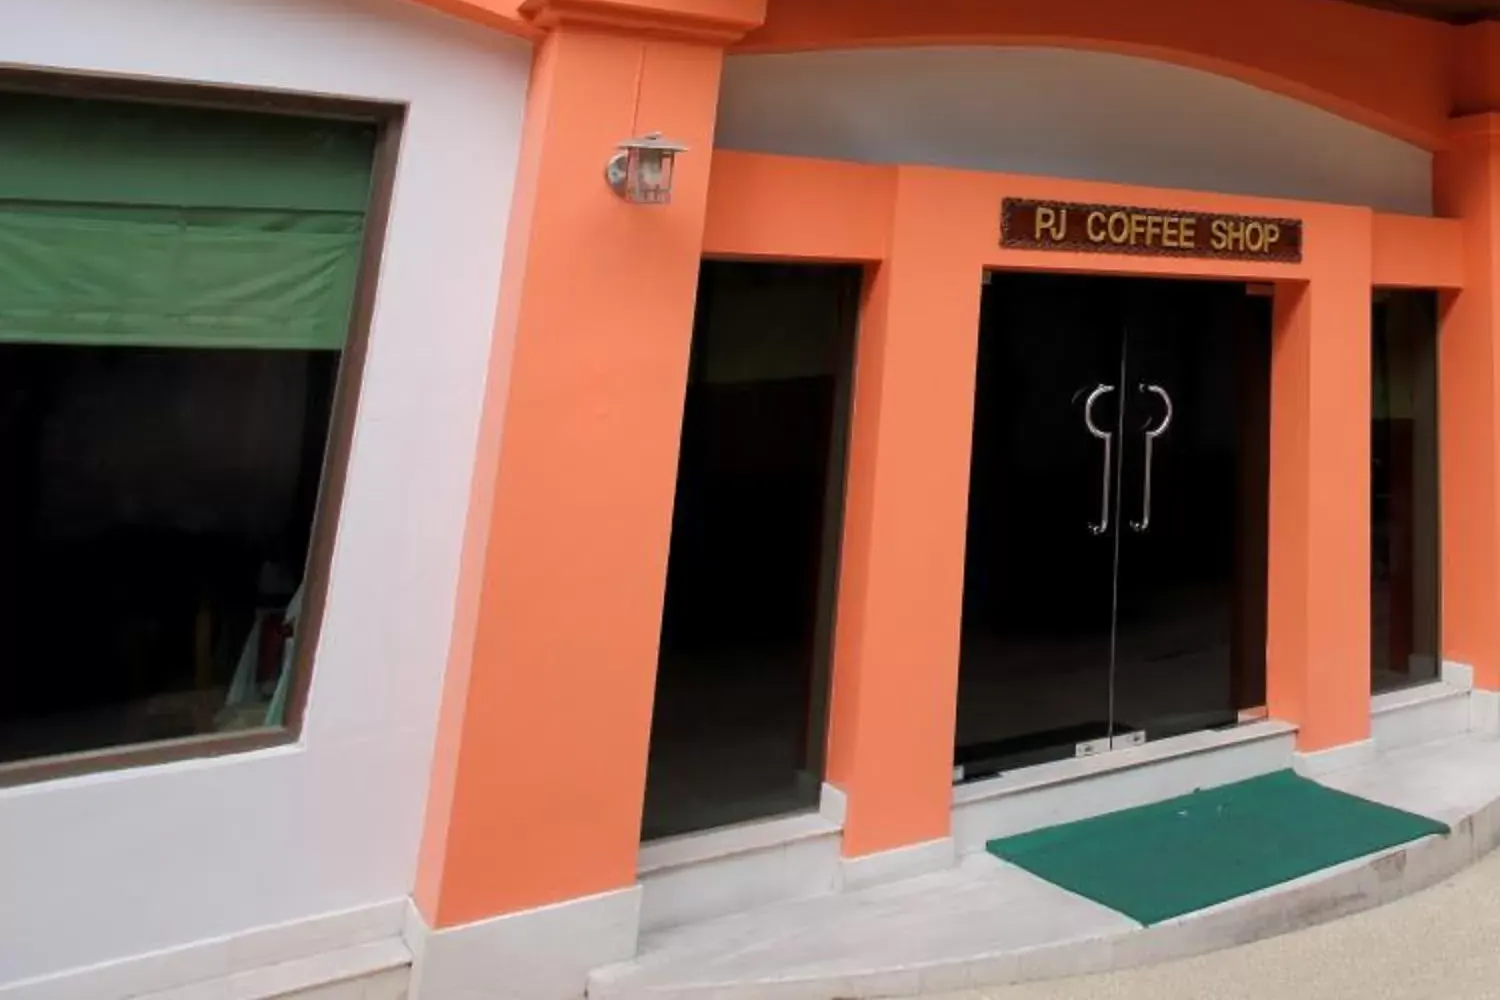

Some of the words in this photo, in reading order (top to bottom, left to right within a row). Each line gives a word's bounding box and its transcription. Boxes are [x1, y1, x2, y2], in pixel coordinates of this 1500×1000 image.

[1034, 206, 1068, 242] PJ
[1087, 210, 1196, 249] COFFEE
[1210, 218, 1281, 253] SHOP
